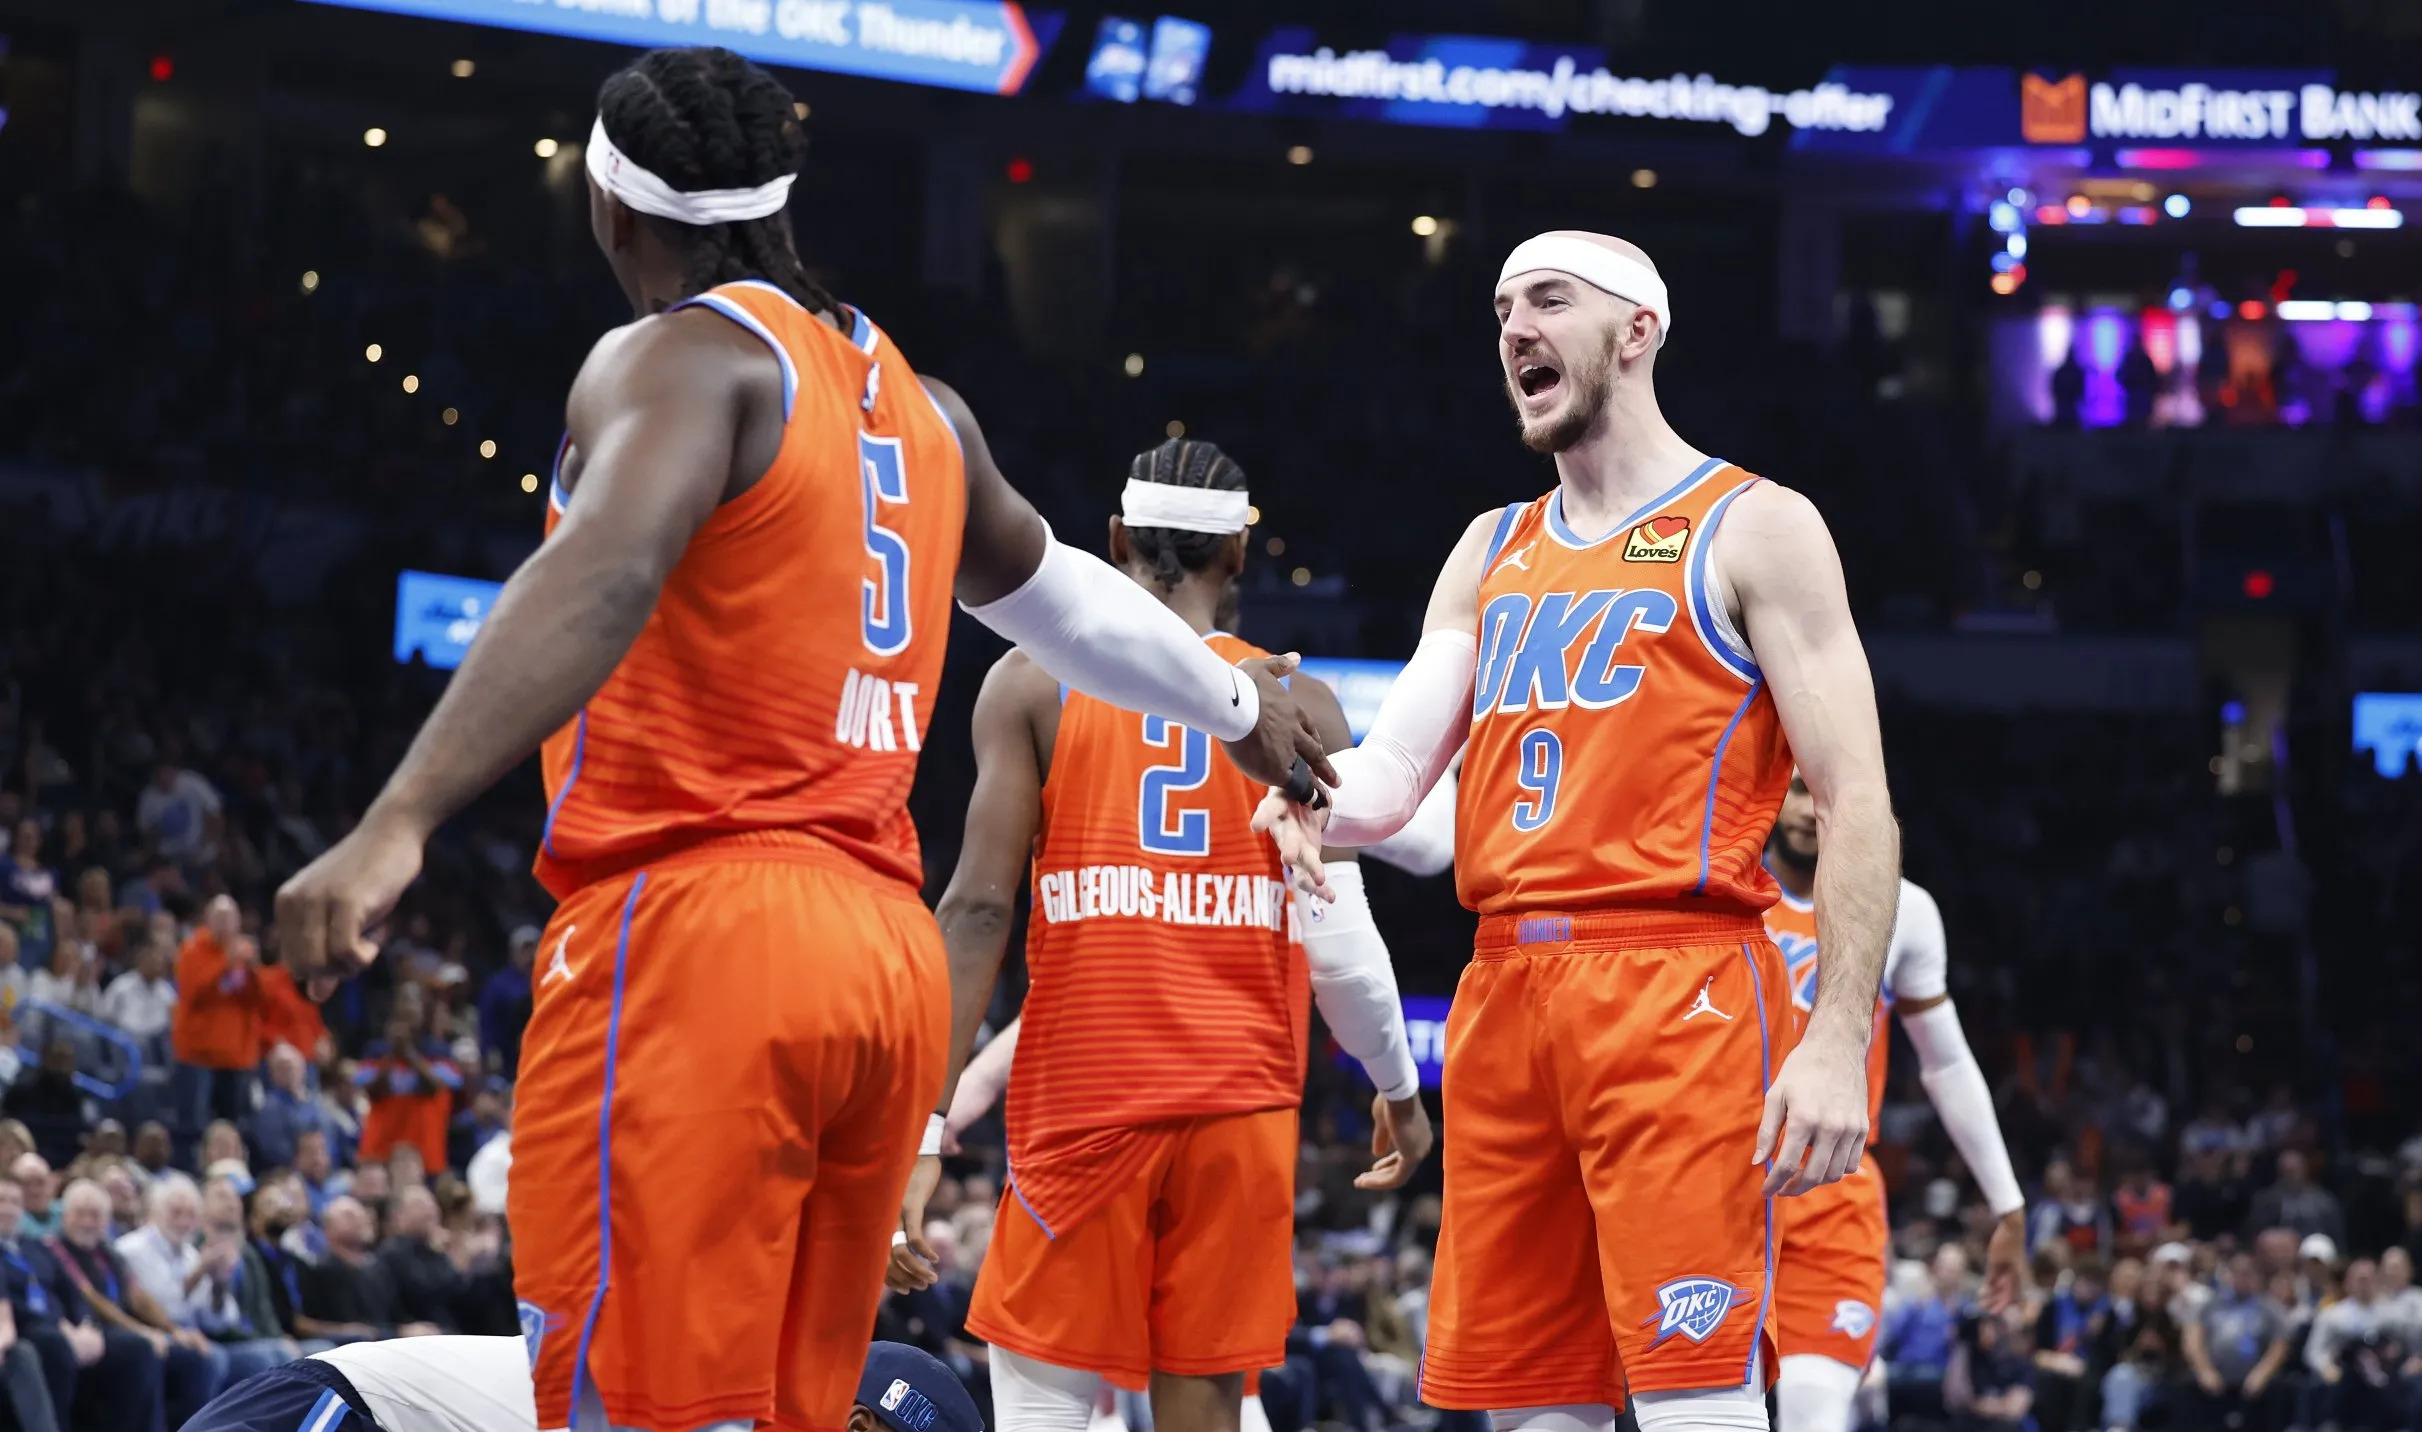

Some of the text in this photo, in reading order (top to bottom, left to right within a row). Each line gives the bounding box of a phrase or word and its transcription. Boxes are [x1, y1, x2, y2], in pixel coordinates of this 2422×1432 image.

[775, 0, 850, 47] OKC
[858, 2, 1004, 66] Thunder
[1268, 46, 1894, 137] midfirst.com/checking-offer
[860, 430, 910, 657] 5
[1473, 588, 1678, 723] OKC
[1138, 713, 1212, 857] 2
[1512, 727, 1563, 833] 9
[1660, 1288, 1718, 1331] OKC
[895, 1389, 939, 1432] OKC
